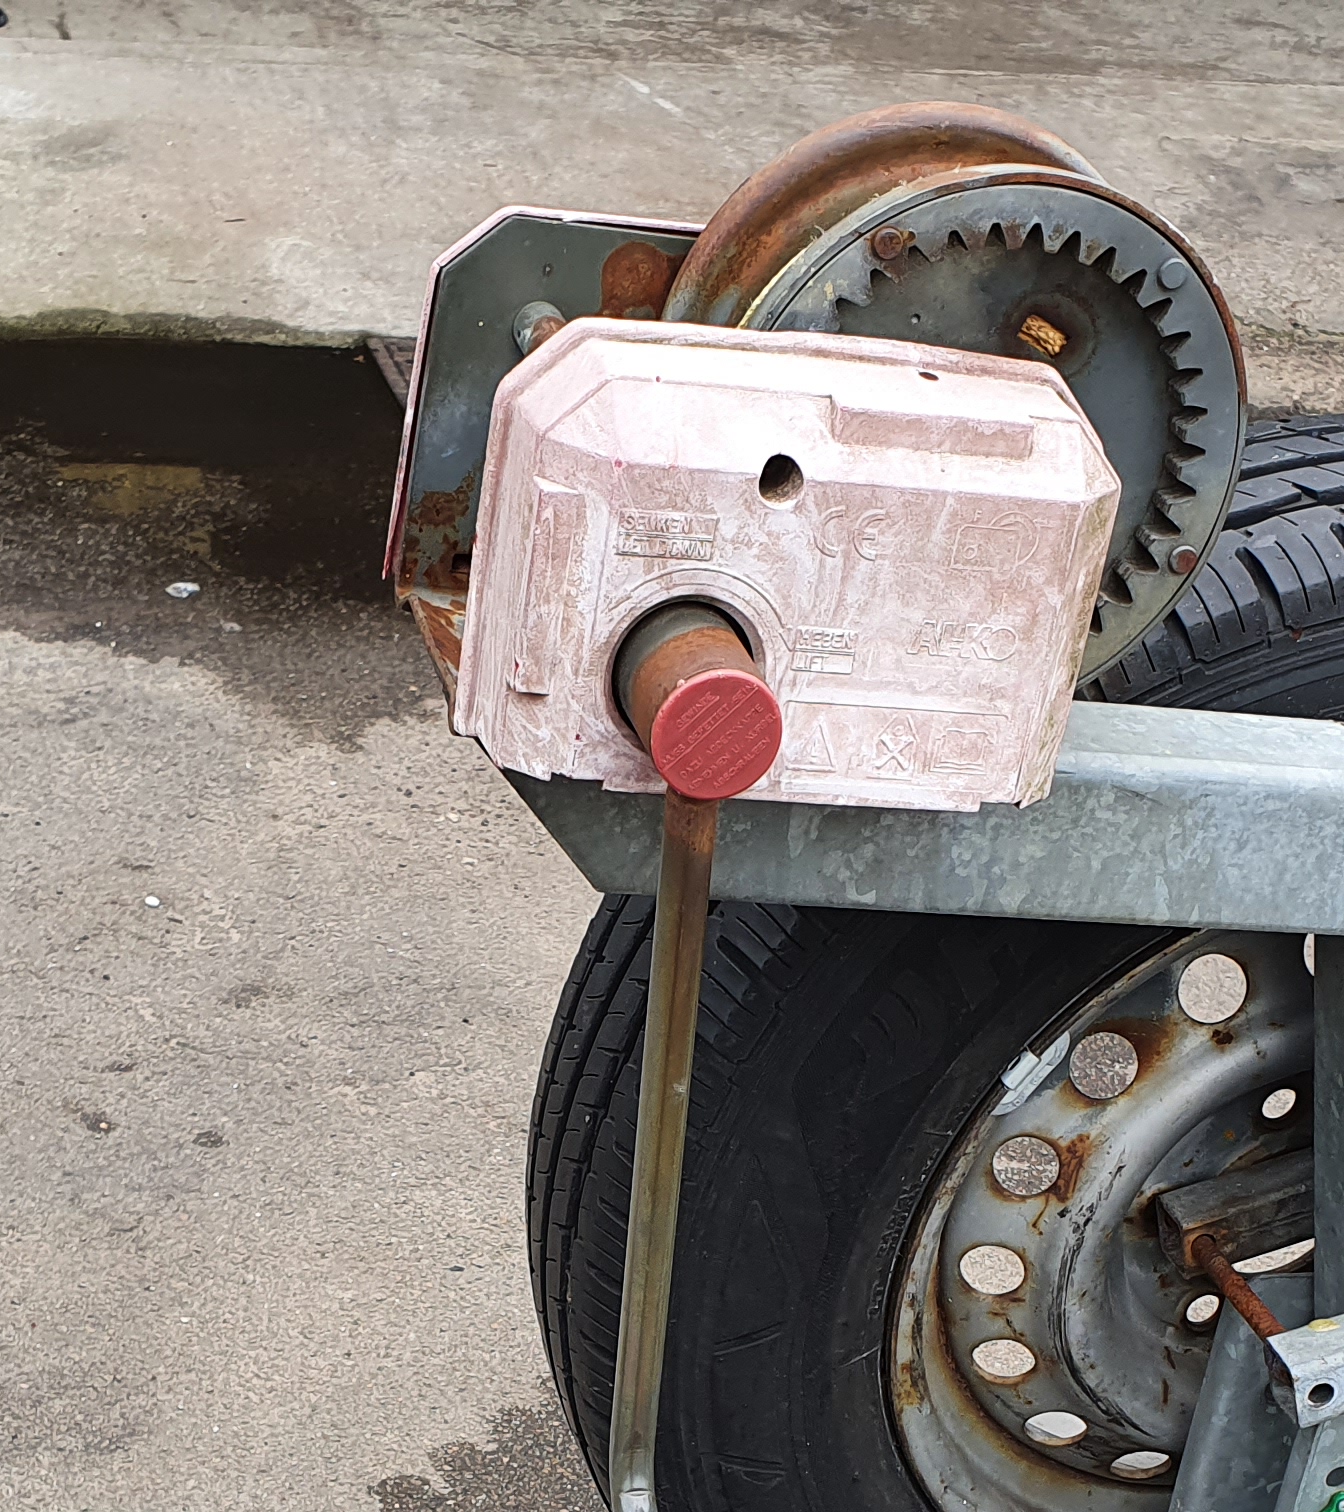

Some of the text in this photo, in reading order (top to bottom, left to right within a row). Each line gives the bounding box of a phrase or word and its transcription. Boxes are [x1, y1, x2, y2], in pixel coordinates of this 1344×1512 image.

[621, 513, 693, 534] SENKEN
[798, 629, 856, 649] HEBEN
[795, 655, 831, 671] LIFT
[676, 690, 720, 728] GEWINDE
[687, 703, 732, 744] GEFETTET
[731, 682, 759, 704] SEIN
